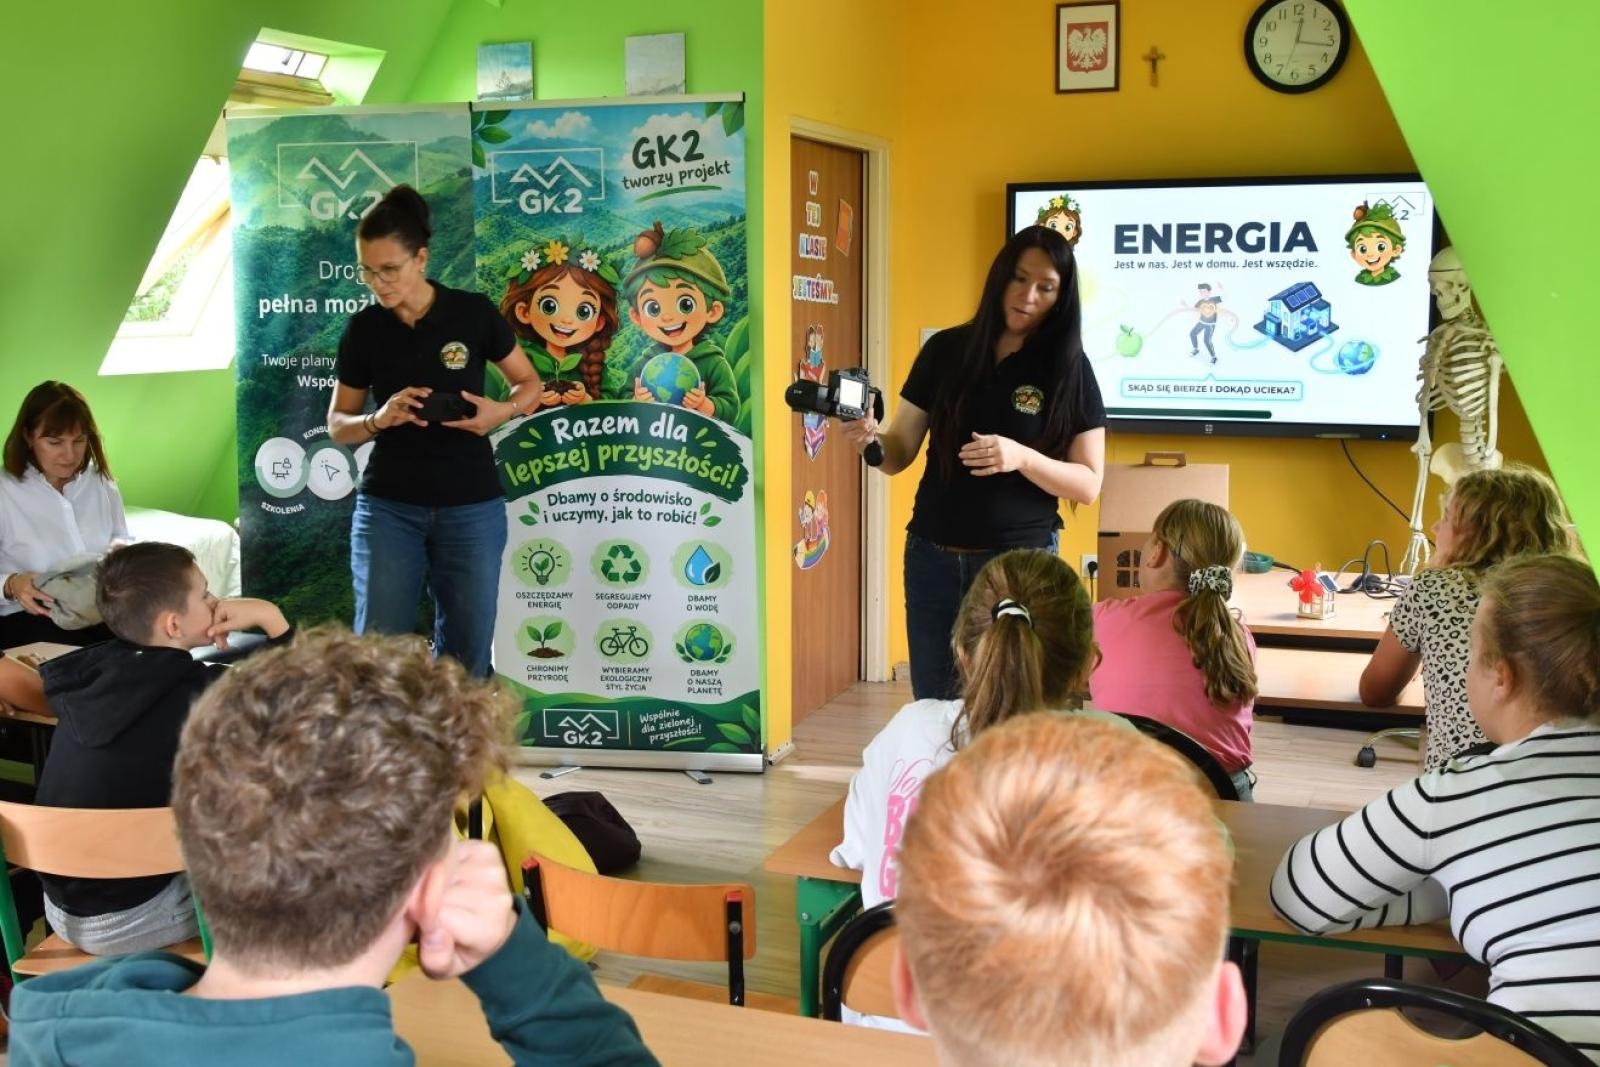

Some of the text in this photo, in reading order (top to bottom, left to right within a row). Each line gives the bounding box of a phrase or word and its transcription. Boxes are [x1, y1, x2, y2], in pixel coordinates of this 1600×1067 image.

[1279, 9, 1287, 20] 11
[1293, 4, 1305, 16] 12
[1266, 21, 1277, 32] 10
[1322, 19, 1331, 31] 2
[1260, 37, 1268, 47] 9
[1263, 52, 1272, 64] 8
[1321, 52, 1328, 63] 4
[1276, 64, 1284, 76] 7
[1290, 69, 1299, 80] 6
[1307, 64, 1316, 76] 5
[632, 130, 705, 169] GK2
[621, 160, 731, 190] tworzy projekt
[519, 188, 583, 215] GK2
[1114, 221, 1318, 254] ENERGIA
[1114, 260, 1134, 269] Jest
[1172, 260, 1192, 269] Jest
[1207, 259, 1239, 268] domu.
[1242, 259, 1263, 268] Jest
[1266, 258, 1318, 270] wszędzie.
[259, 294, 317, 318] pełna
[262, 354, 336, 369] Twoje plany
[297, 374, 336, 391] Wspó
[1128, 384, 1154, 393] SKĄD
[1157, 384, 1171, 394] SIĘ
[1173, 385, 1207, 393] BIERZE
[1215, 385, 1250, 395] DOKĄD
[1254, 386, 1296, 395] UCIEKA?
[551, 412, 688, 444] Razem dla
[505, 442, 740, 489] lepszej przyszłości!
[547, 488, 692, 507] Dbamy o środowisko
[261, 502, 305, 515] SZKOLENIA
[543, 506, 697, 524] i uczymy, jak to robić!
[516, 592, 573, 601] OSZCZĘDZAMY
[596, 593, 652, 601] SEGREGUJEMY
[528, 601, 562, 610] ENERGIĘ
[607, 602, 639, 610] ODPADY
[696, 604, 719, 613] WODĘ
[528, 674, 568, 682] PRZYRODĘ
[690, 669, 719, 677] DBAMY
[688, 687, 722, 696] PLANETĘ
[639, 709, 680, 724] Wspólnie
[641, 716, 695, 734] dla zielonej
[563, 730, 603, 745] GK2
[650, 724, 702, 744] przyszłości!
